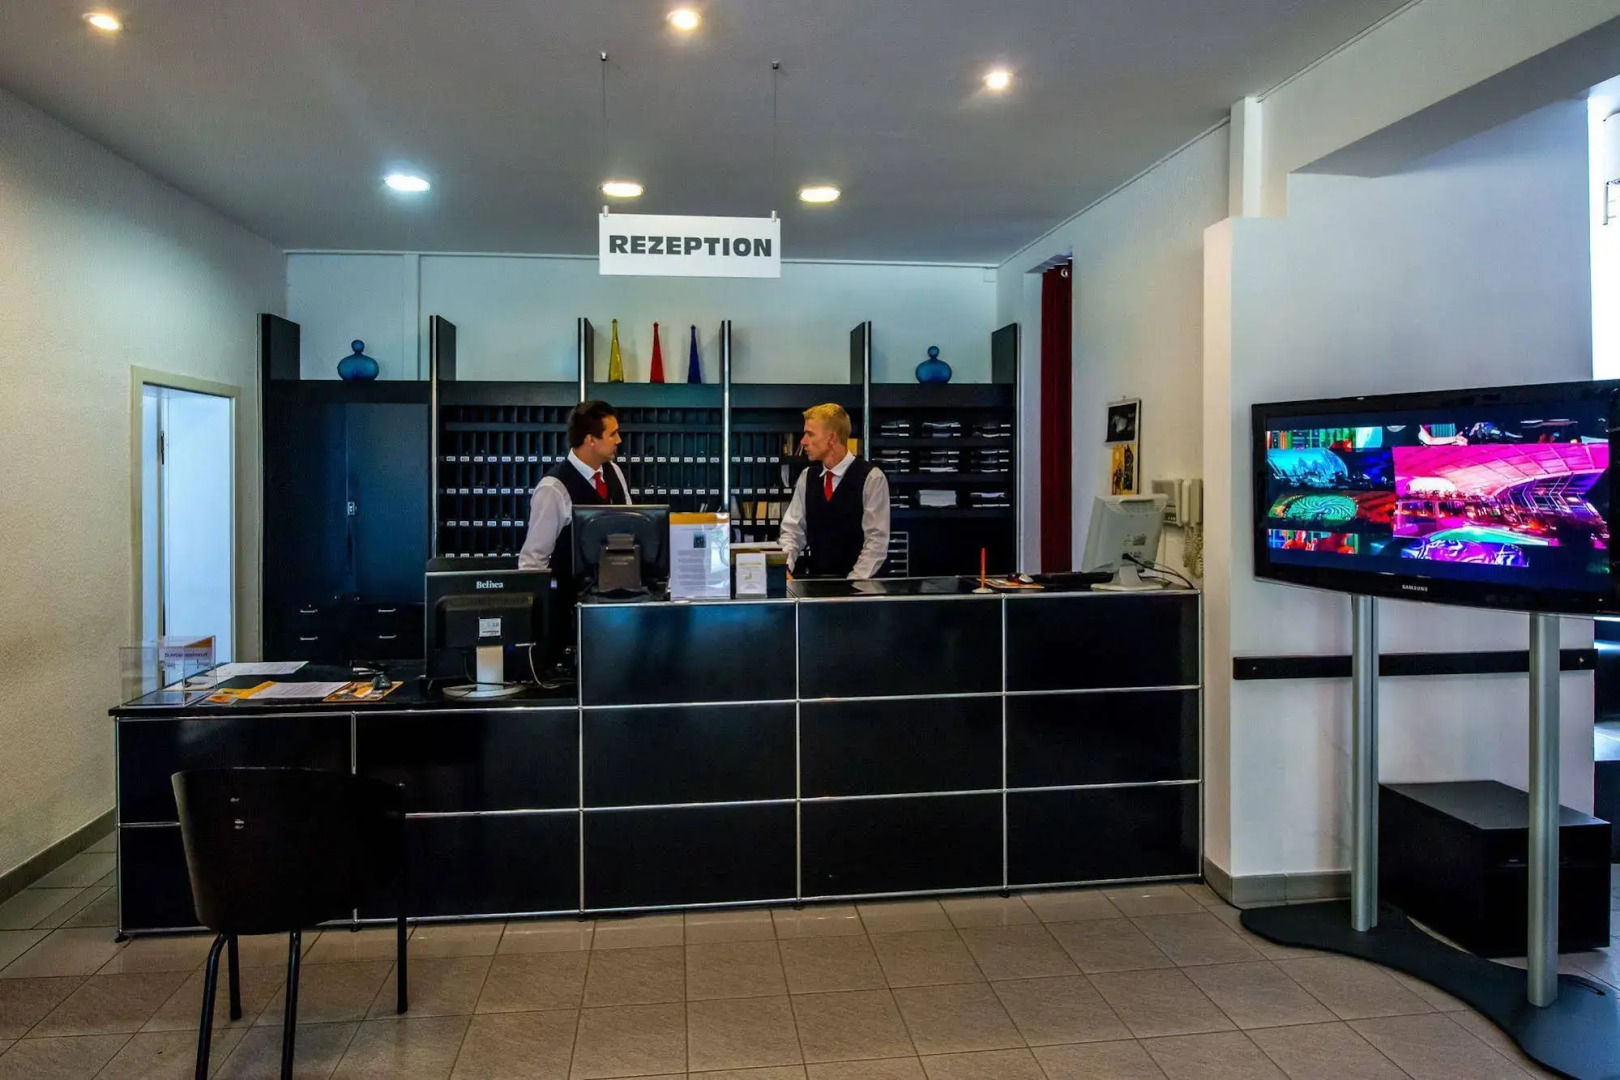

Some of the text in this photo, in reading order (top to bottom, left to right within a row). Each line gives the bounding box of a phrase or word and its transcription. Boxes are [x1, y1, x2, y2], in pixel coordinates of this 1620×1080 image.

[609, 235, 772, 257] REZEPTION
[476, 579, 504, 589] Belinea
[1402, 584, 1429, 592] SAMSUNG
